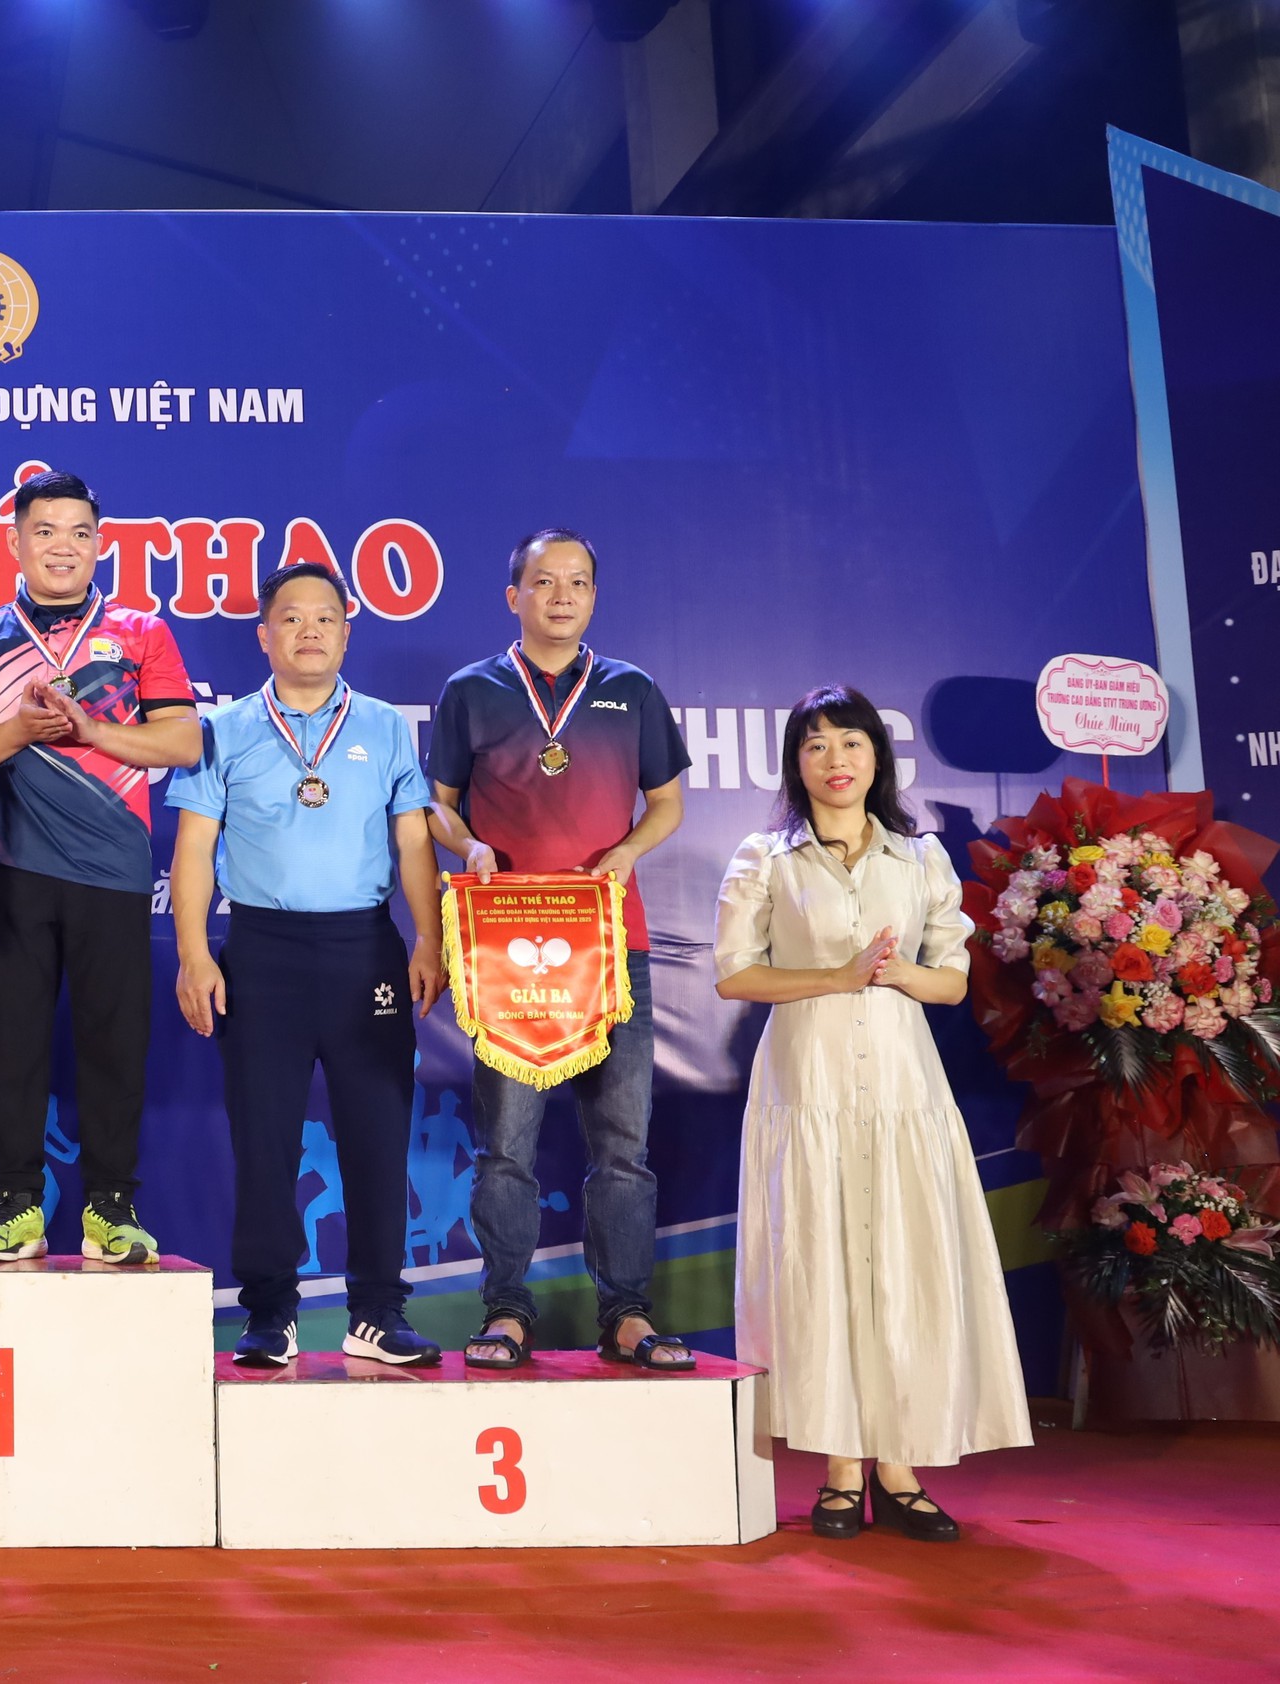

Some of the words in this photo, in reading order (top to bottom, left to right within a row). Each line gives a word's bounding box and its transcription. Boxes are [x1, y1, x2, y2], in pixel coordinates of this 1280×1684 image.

[109, 380, 196, 430] VIỆT
[208, 388, 304, 423] NAM
[590, 700, 628, 712] JOOLA
[1075, 711, 1104, 730] Chúc
[1106, 715, 1141, 736] Mừng
[494, 894, 518, 904] GIẢI
[521, 894, 542, 904] THỂ
[545, 895, 576, 904] THAO
[511, 983, 547, 1003] GIẢI
[551, 989, 572, 1003] BA
[499, 1010, 524, 1019] BÓNG
[528, 1010, 546, 1019] BÀN
[550, 1010, 565, 1019] ĐÔI
[476, 1427, 528, 1514] 3
